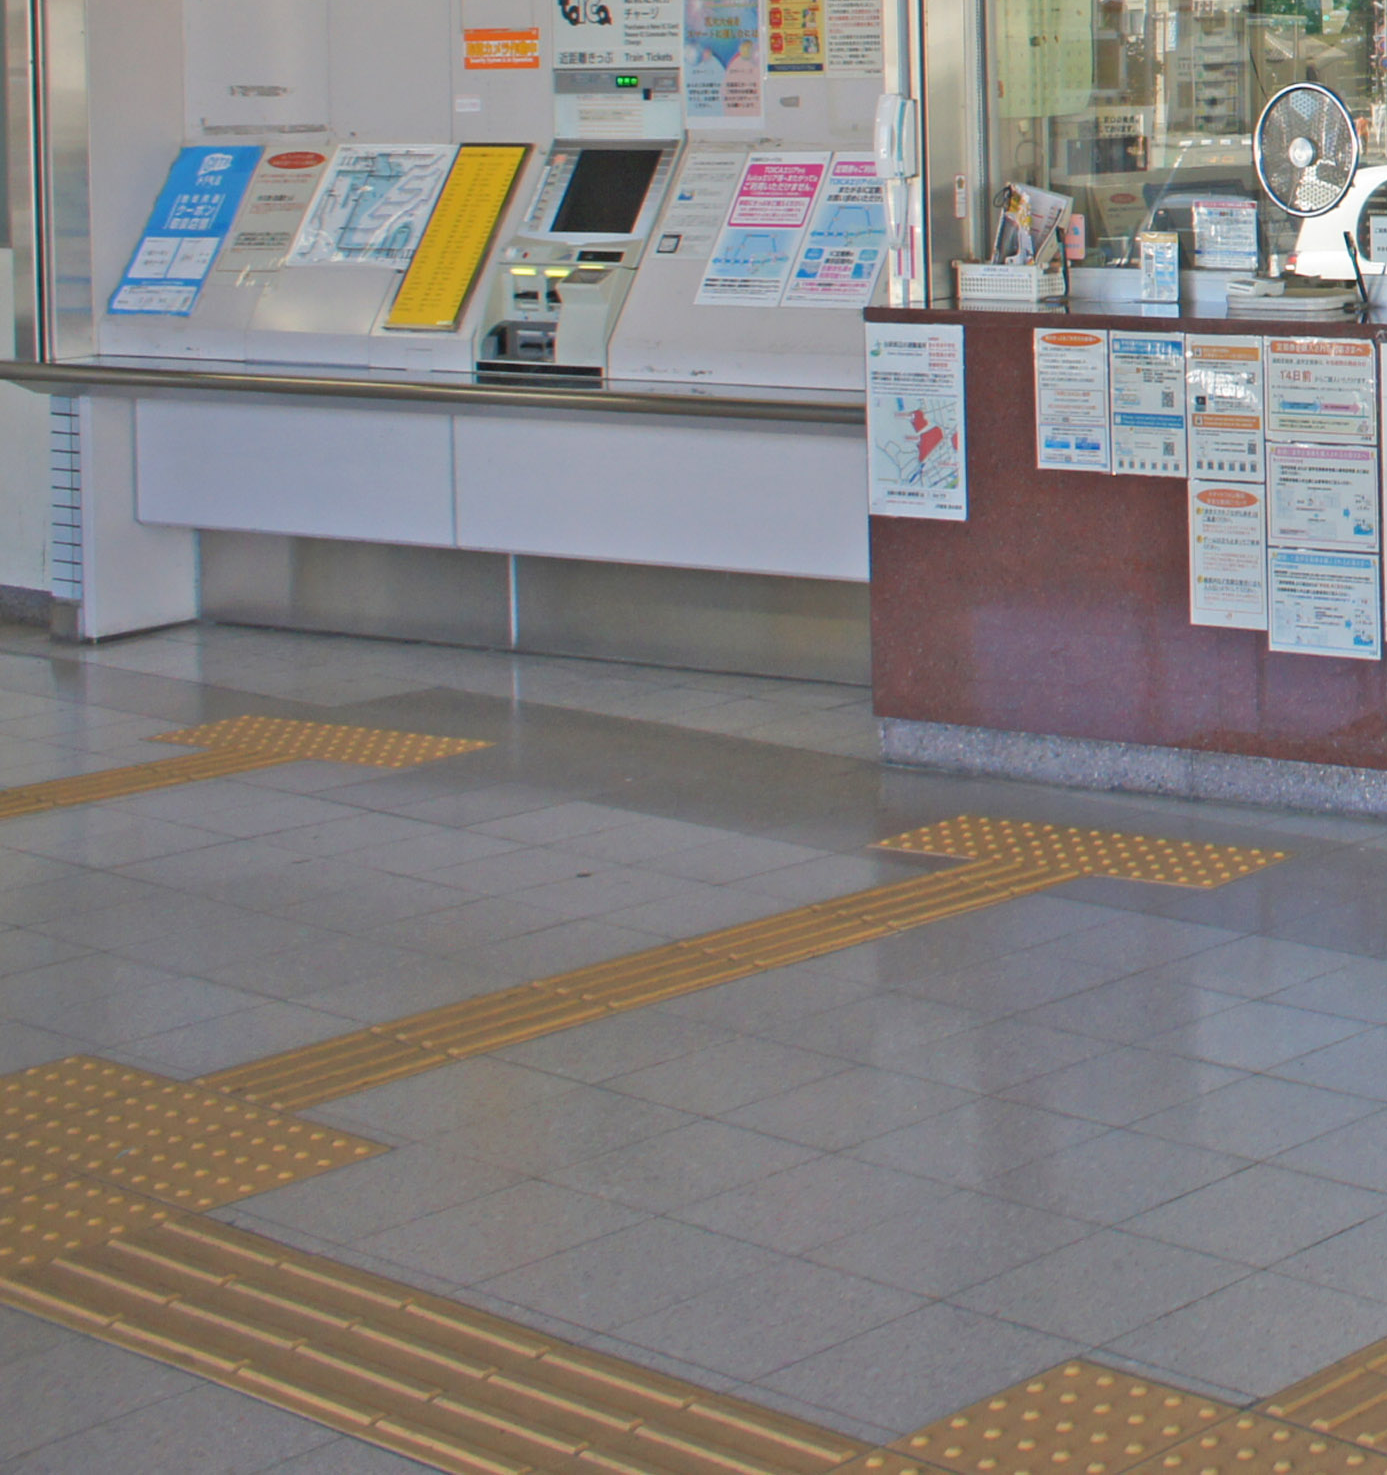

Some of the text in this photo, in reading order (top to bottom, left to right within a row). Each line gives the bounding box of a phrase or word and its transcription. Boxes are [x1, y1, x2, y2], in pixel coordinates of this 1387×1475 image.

[625, 52, 673, 62] Train Tickets
[1280, 368, 1313, 383] 14日前
